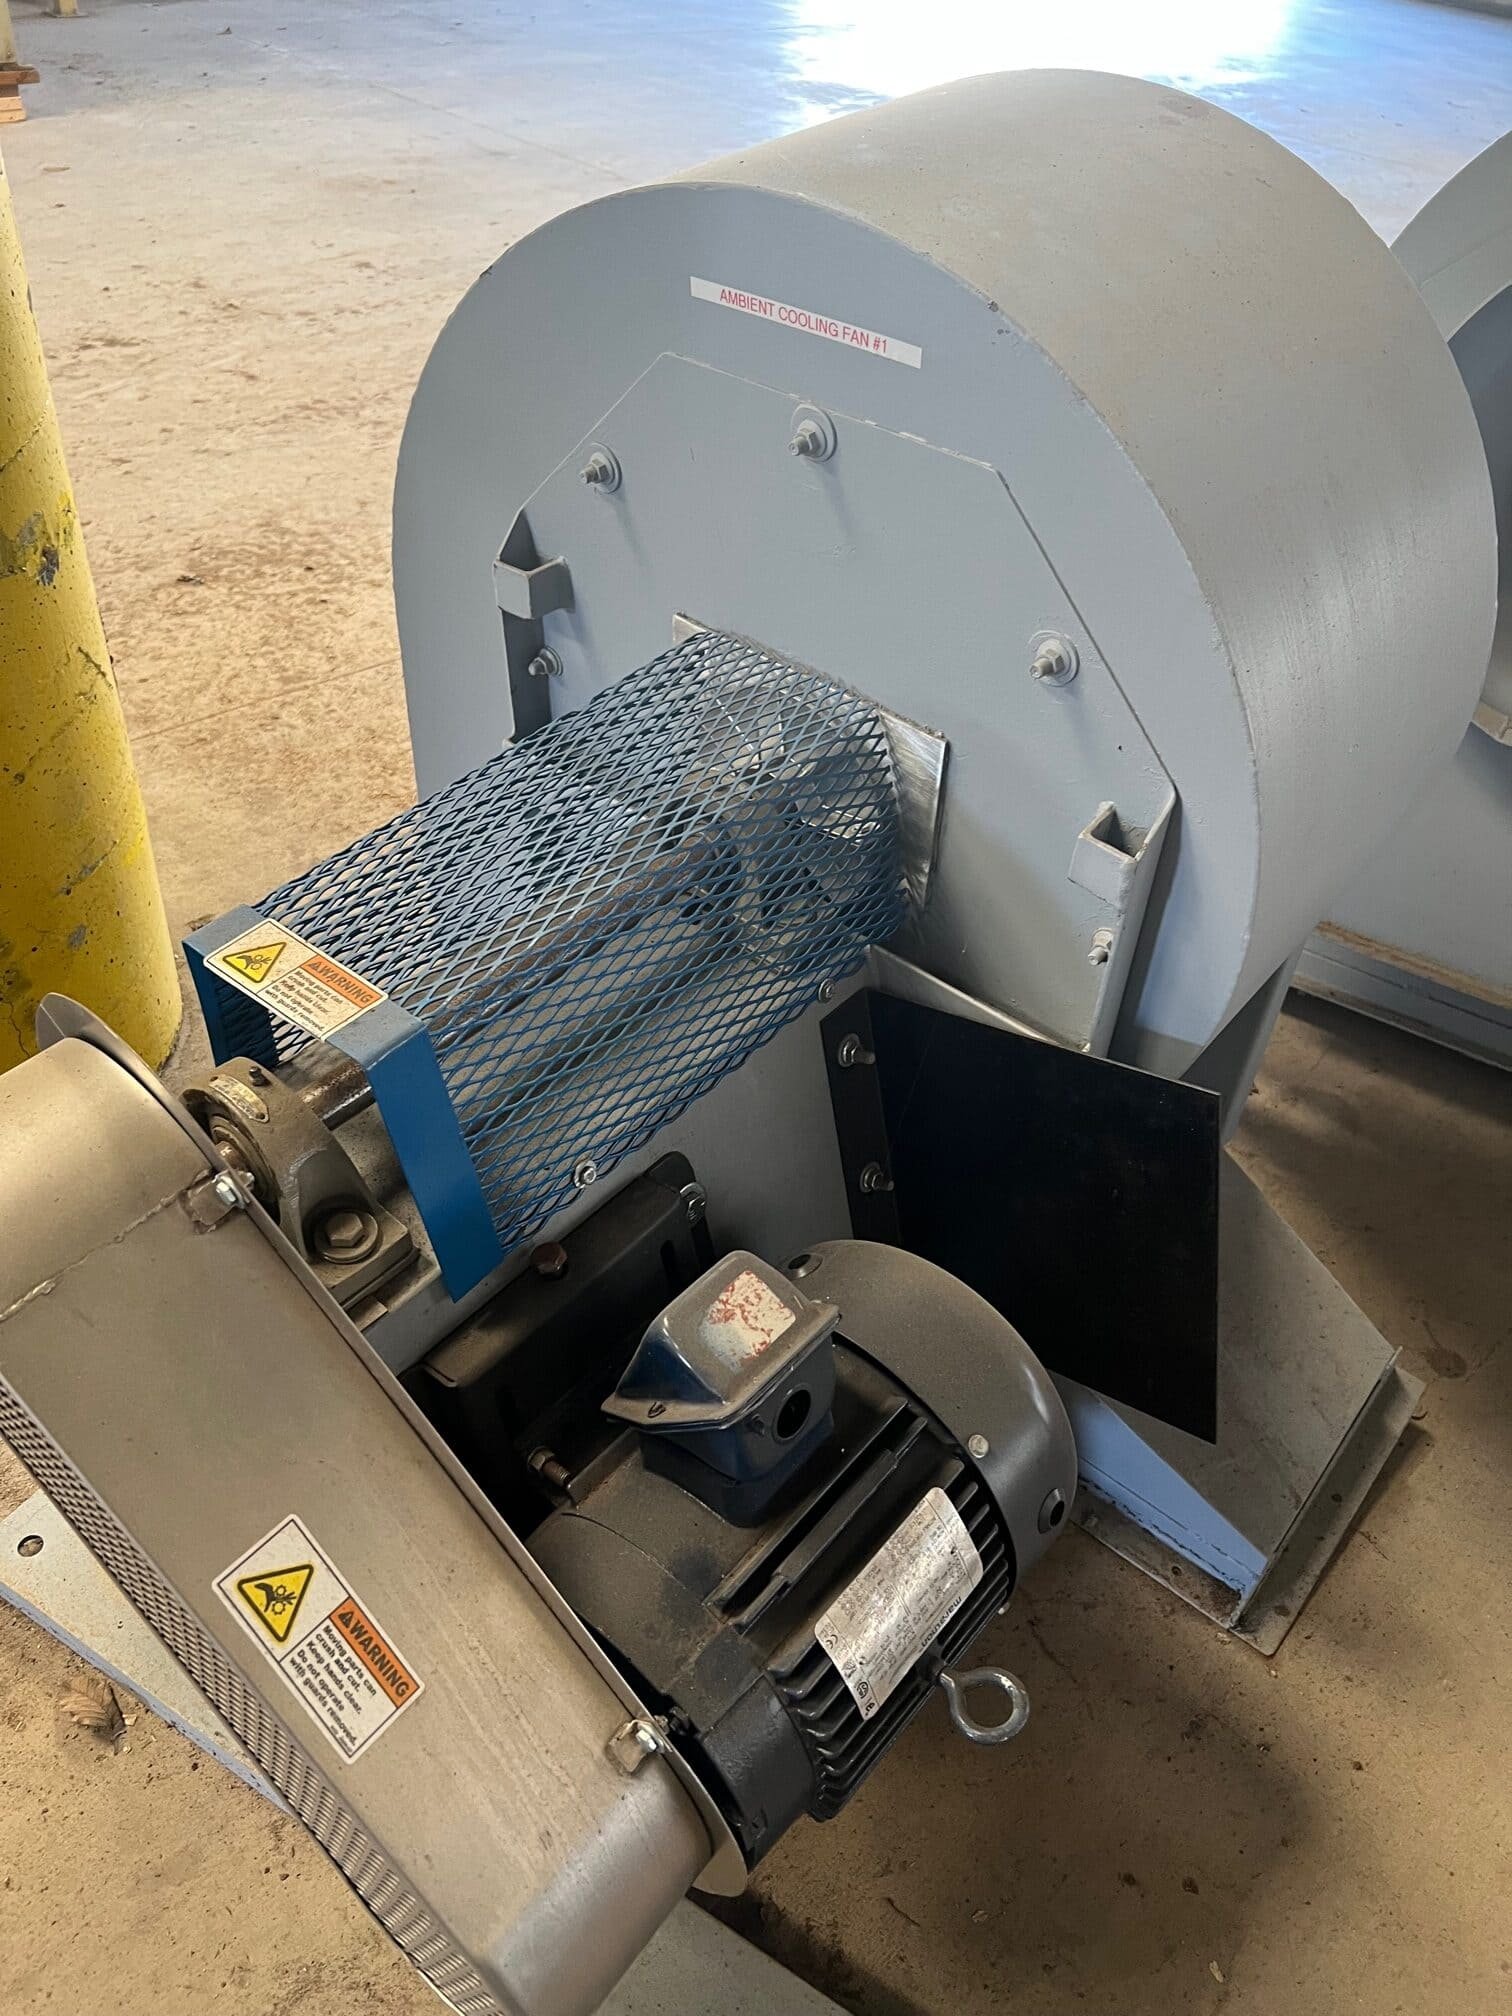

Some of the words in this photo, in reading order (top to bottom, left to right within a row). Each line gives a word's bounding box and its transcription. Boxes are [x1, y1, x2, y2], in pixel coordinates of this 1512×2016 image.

[720, 289, 775, 316] AMBIENT
[778, 307, 839, 337] COOLING
[843, 327, 869, 347] FAN
[873, 337, 888, 353] #1
[264, 990, 279, 999] with
[276, 998, 298, 1012] guards
[294, 970, 316, 986] Moving
[313, 983, 331, 996] parts
[330, 994, 343, 1004] can
[304, 985, 317, 994] and
[318, 964, 373, 1003] WARNING
[921, 1597, 961, 1648] marathon
[296, 1649, 309, 1663] Do
[306, 1662, 320, 1678] not
[318, 1678, 345, 1711] operate
[305, 1640, 326, 1664] Keep
[323, 1662, 346, 1690] hands
[342, 1689, 364, 1714] clear.
[314, 1632, 336, 1657] crush
[333, 1657, 349, 1674] and
[346, 1673, 362, 1692] cut.
[322, 1625, 348, 1657] Moving
[344, 1655, 365, 1678] parts
[362, 1678, 377, 1695] can
[349, 1619, 411, 1698] WARNING
[289, 1657, 307, 1678] with
[303, 1677, 329, 1707] guards
[326, 1706, 359, 1746] removed.
